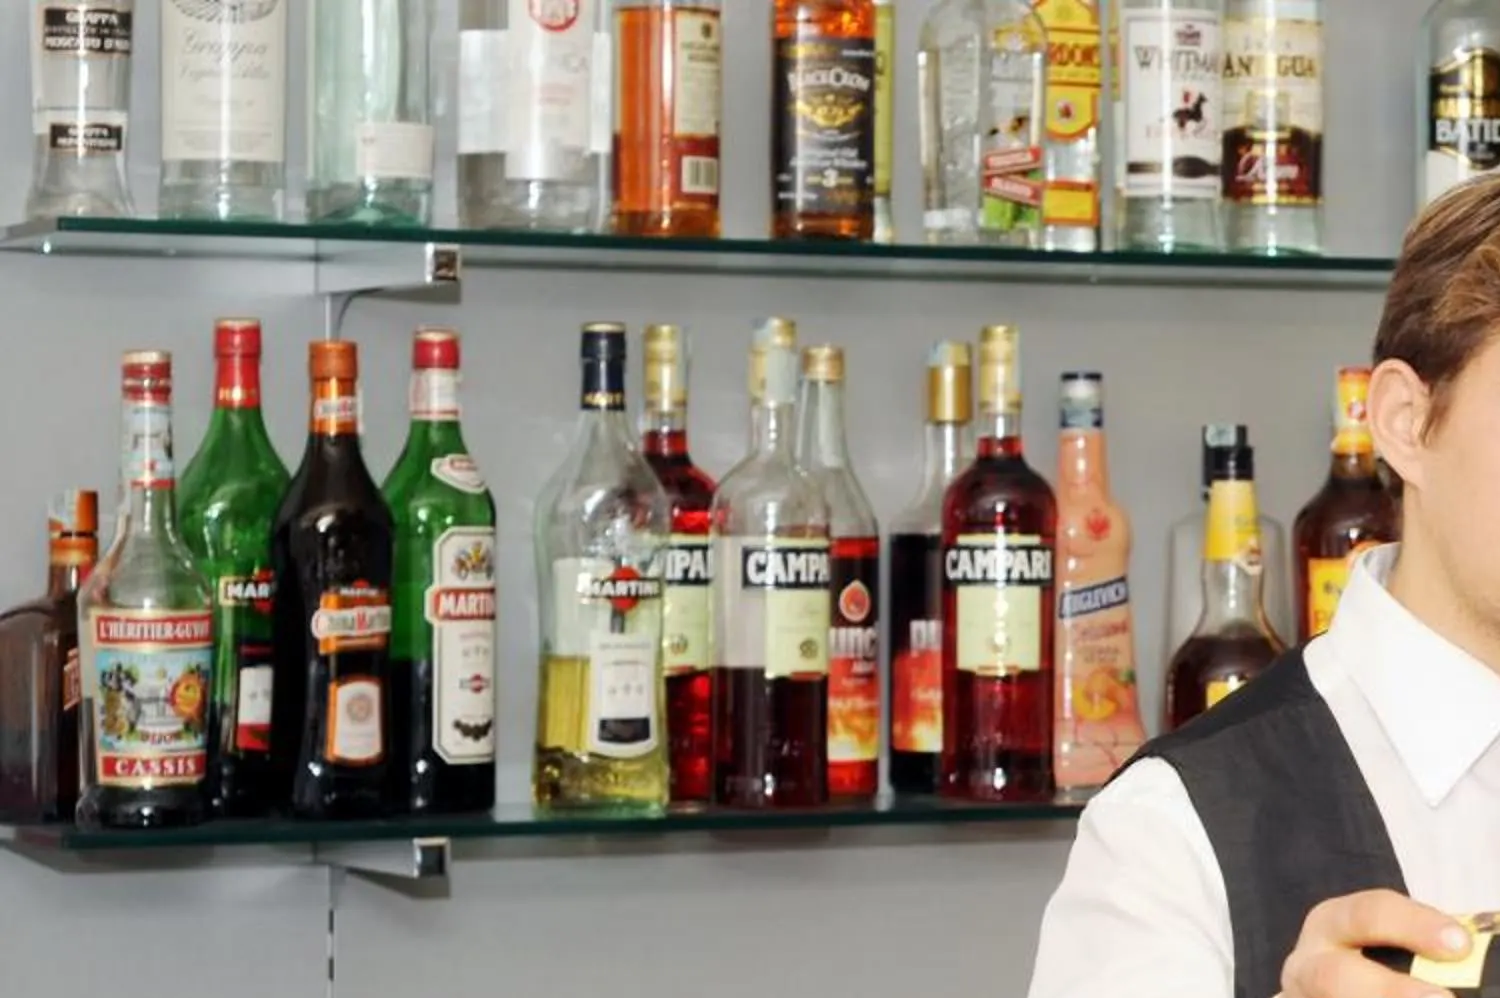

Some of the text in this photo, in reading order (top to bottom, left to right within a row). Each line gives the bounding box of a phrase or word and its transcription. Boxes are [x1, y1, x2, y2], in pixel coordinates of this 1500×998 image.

[1222, 54, 1317, 78] ANGUA
[945, 549, 1051, 580] CAMPARI
[115, 758, 197, 776] CASSIS
